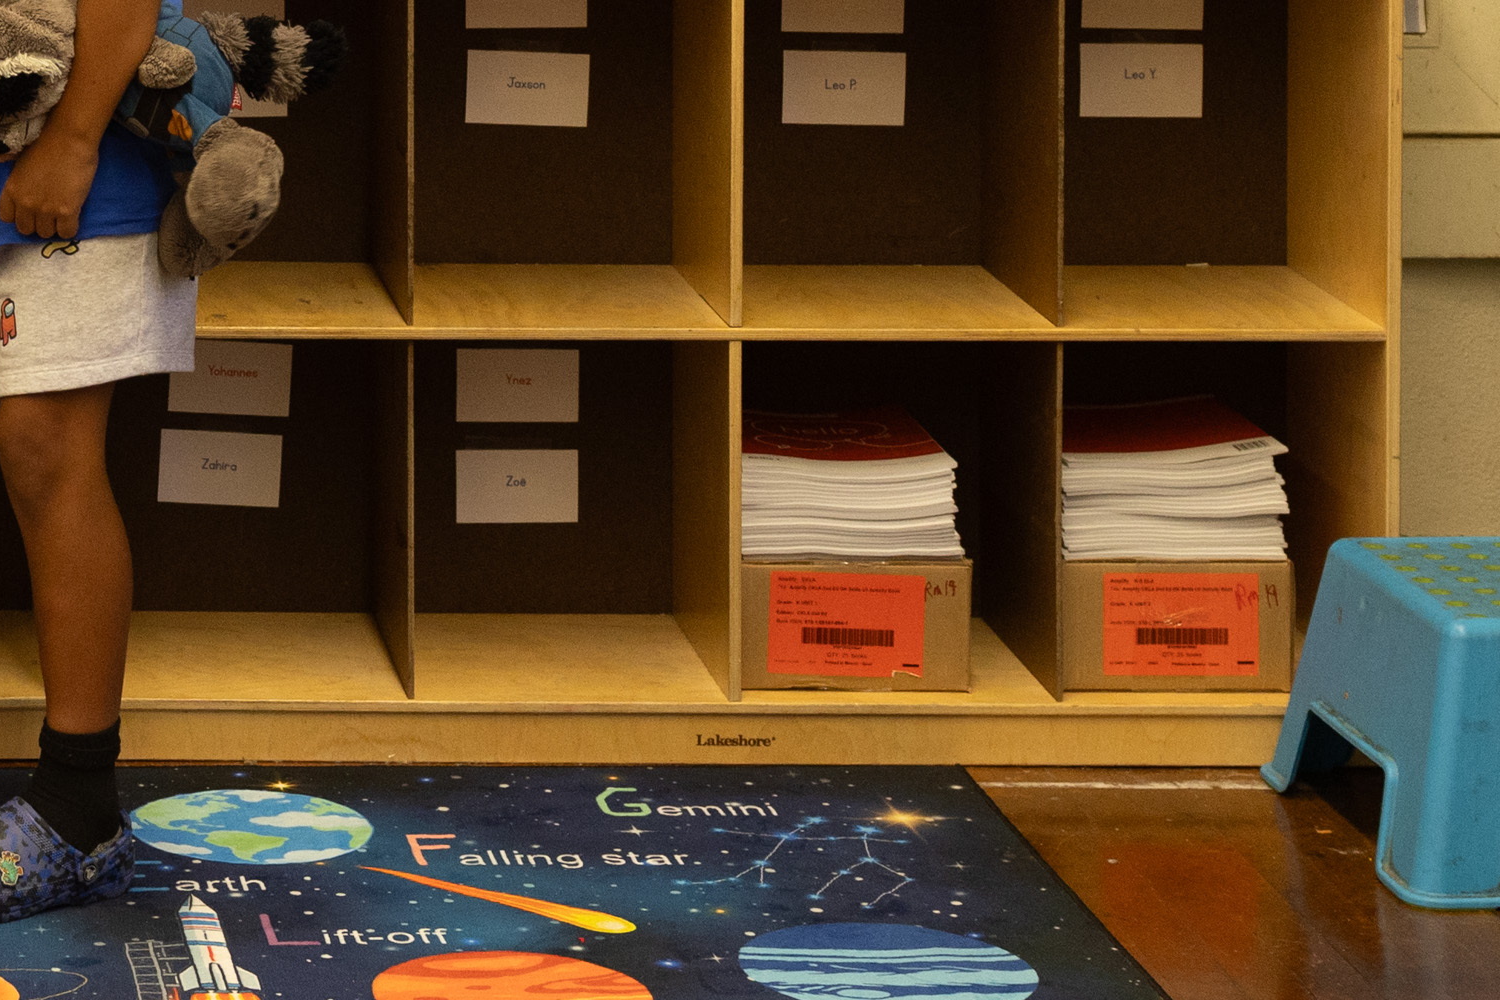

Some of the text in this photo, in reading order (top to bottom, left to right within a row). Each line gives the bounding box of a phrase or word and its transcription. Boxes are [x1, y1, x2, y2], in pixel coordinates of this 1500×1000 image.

[1124, 68, 1146, 80] Leo
[506, 76, 546, 90] Jaxson
[824, 78, 846, 90] Leo
[505, 373, 532, 386] Ynez
[201, 457, 238, 472] Zahira
[696, 734, 772, 747] Lakeshore
[595, 787, 779, 817] Gemini
[405, 833, 689, 869] Falling star
[259, 913, 449, 947] Lift-off
